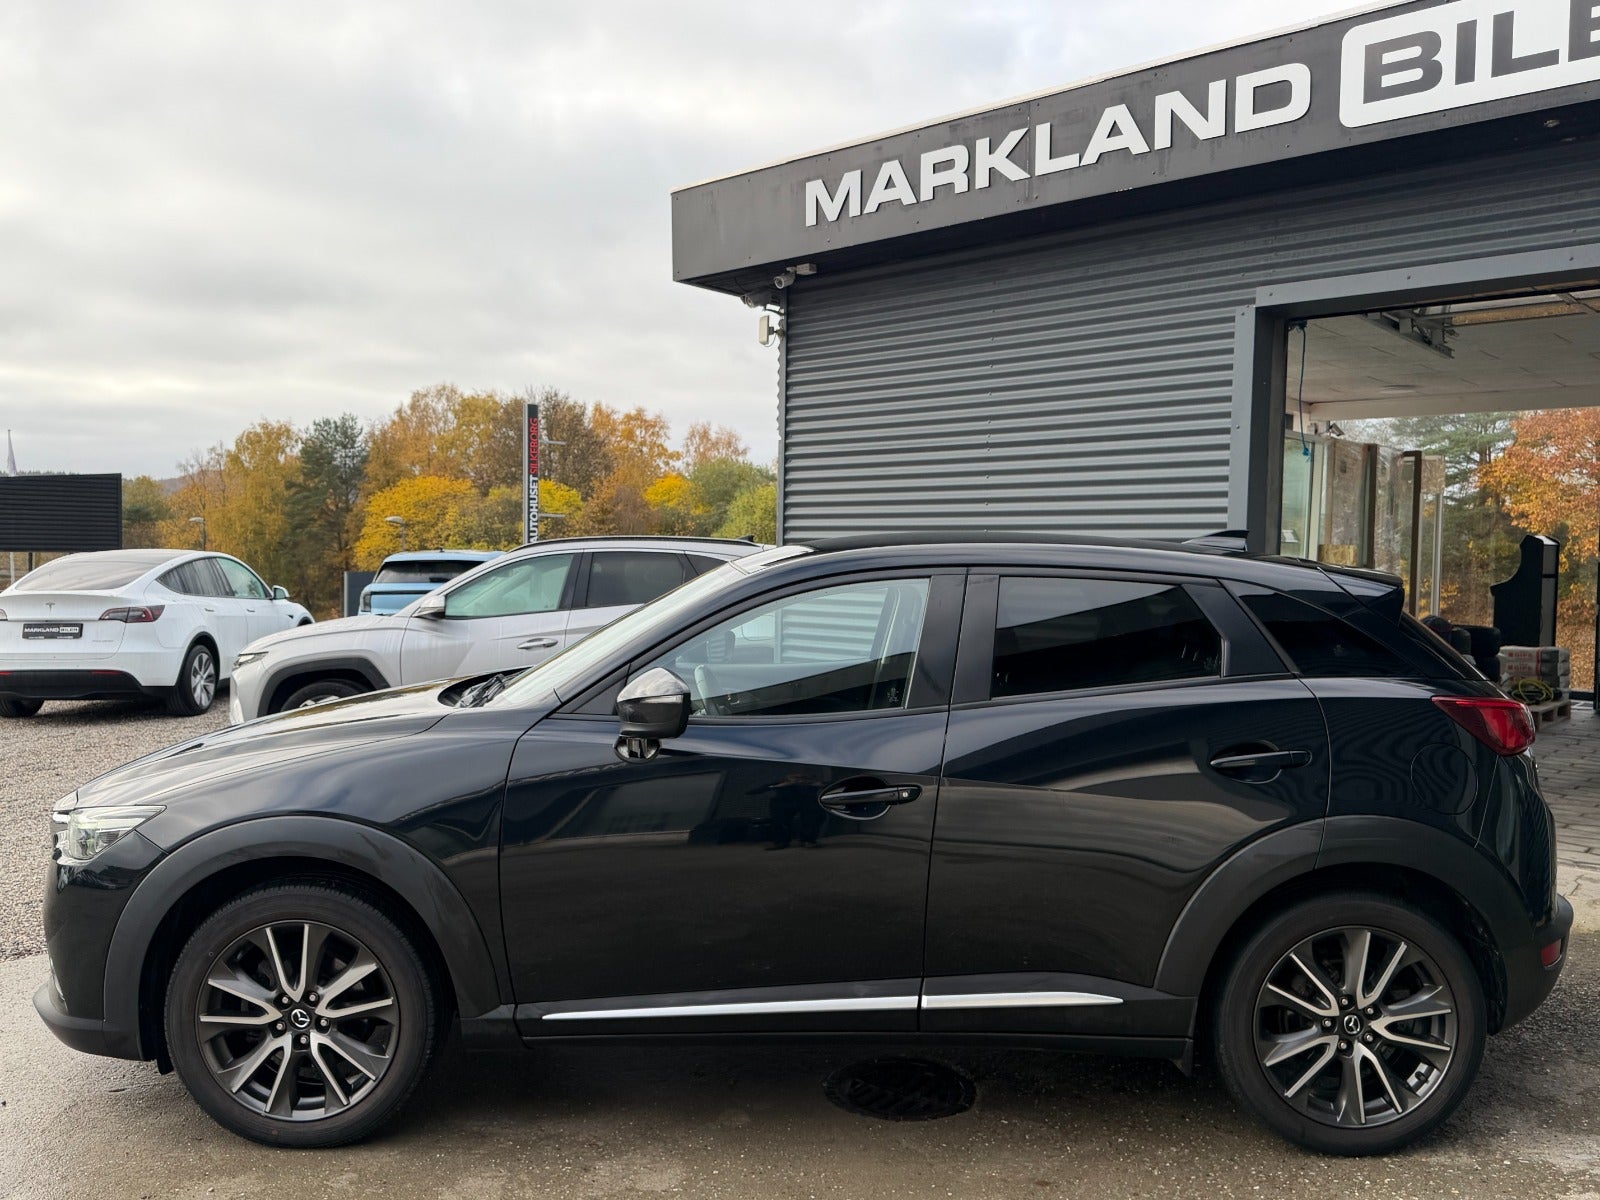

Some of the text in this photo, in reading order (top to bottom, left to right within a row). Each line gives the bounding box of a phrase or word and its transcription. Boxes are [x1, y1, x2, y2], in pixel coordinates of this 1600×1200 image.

[805, 63, 1312, 227] MARKLAND
[529, 417, 539, 543] AUTOHUSET SILKEBORG
